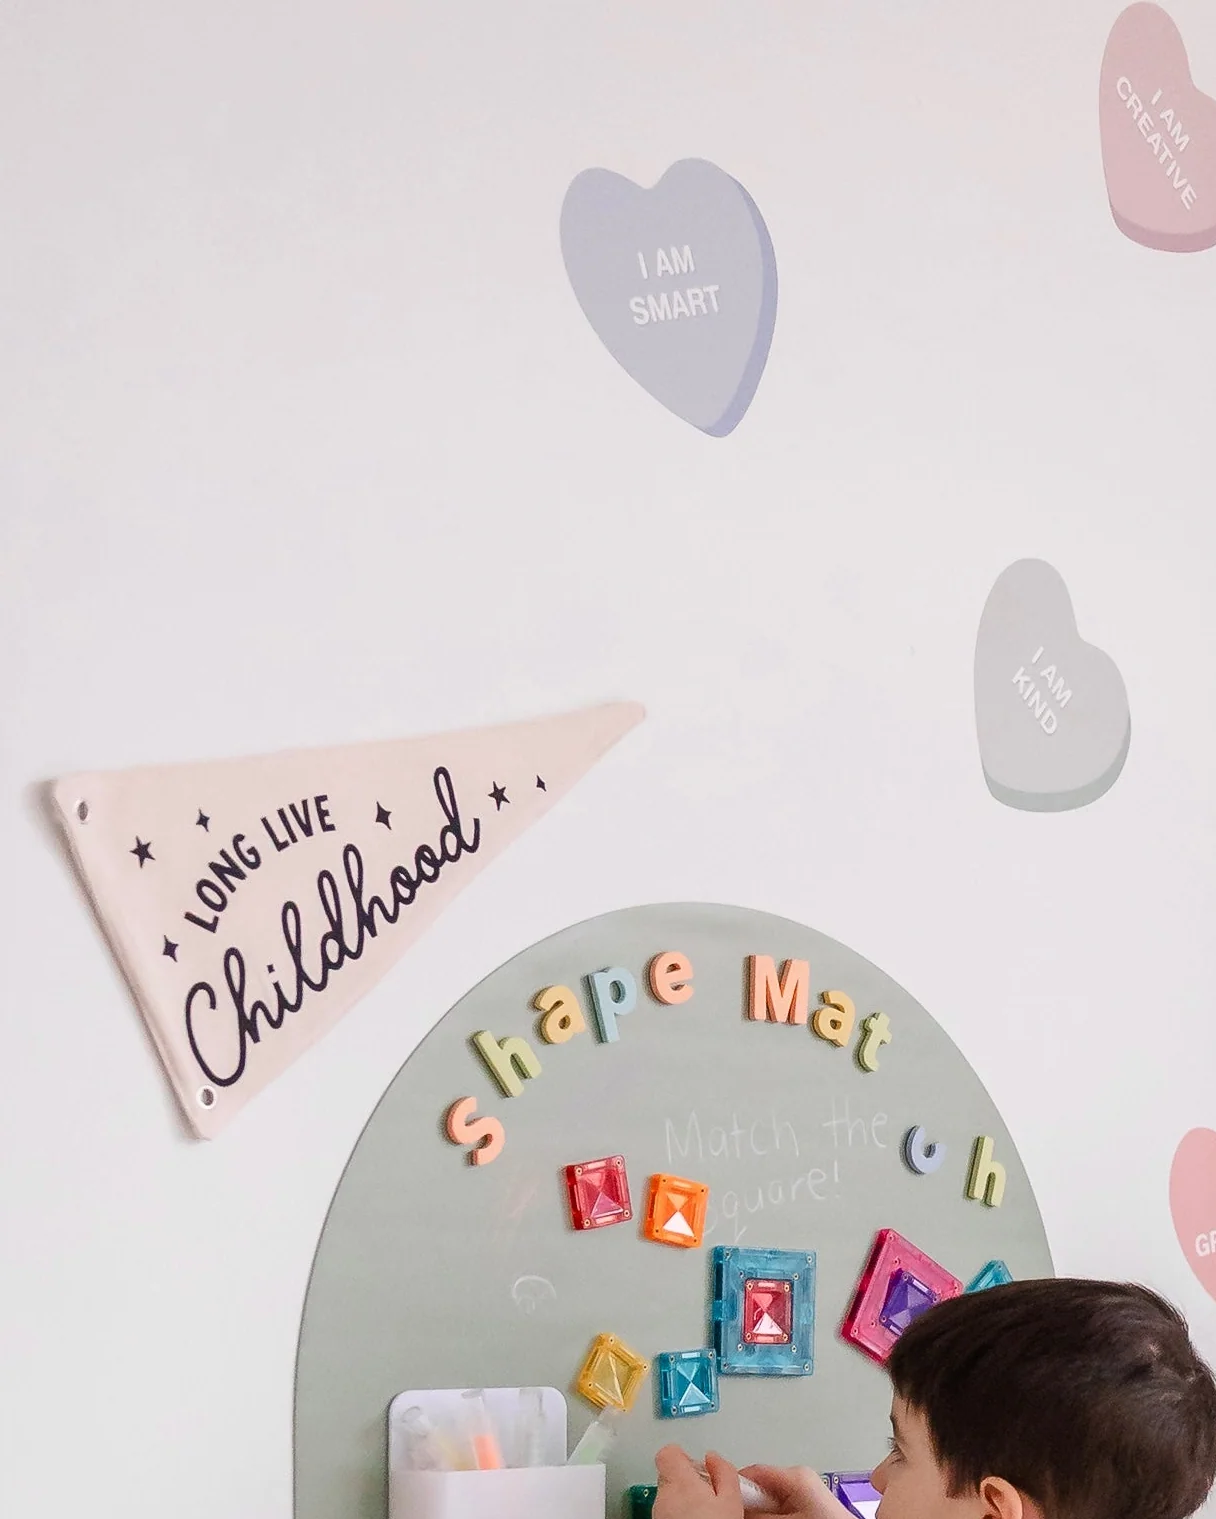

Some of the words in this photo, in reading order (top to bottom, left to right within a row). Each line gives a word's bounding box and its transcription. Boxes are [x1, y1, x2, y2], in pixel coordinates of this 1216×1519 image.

[1115, 76, 1197, 211] CREATIVE
[1151, 88, 1163, 105] I
[1159, 107, 1190, 152] AM
[637, 251, 648, 280] I
[656, 245, 696, 277] AM
[629, 284, 720, 326] SMART
[1011, 666, 1058, 735] KIND
[1031, 645, 1044, 664] I
[1039, 664, 1073, 709] AM
[184, 833, 261, 933] LONG
[260, 794, 336, 853] LIVE
[184, 766, 481, 1087] Childhood
[664, 1109, 799, 1165] Match
[822, 1097, 889, 1149] the
